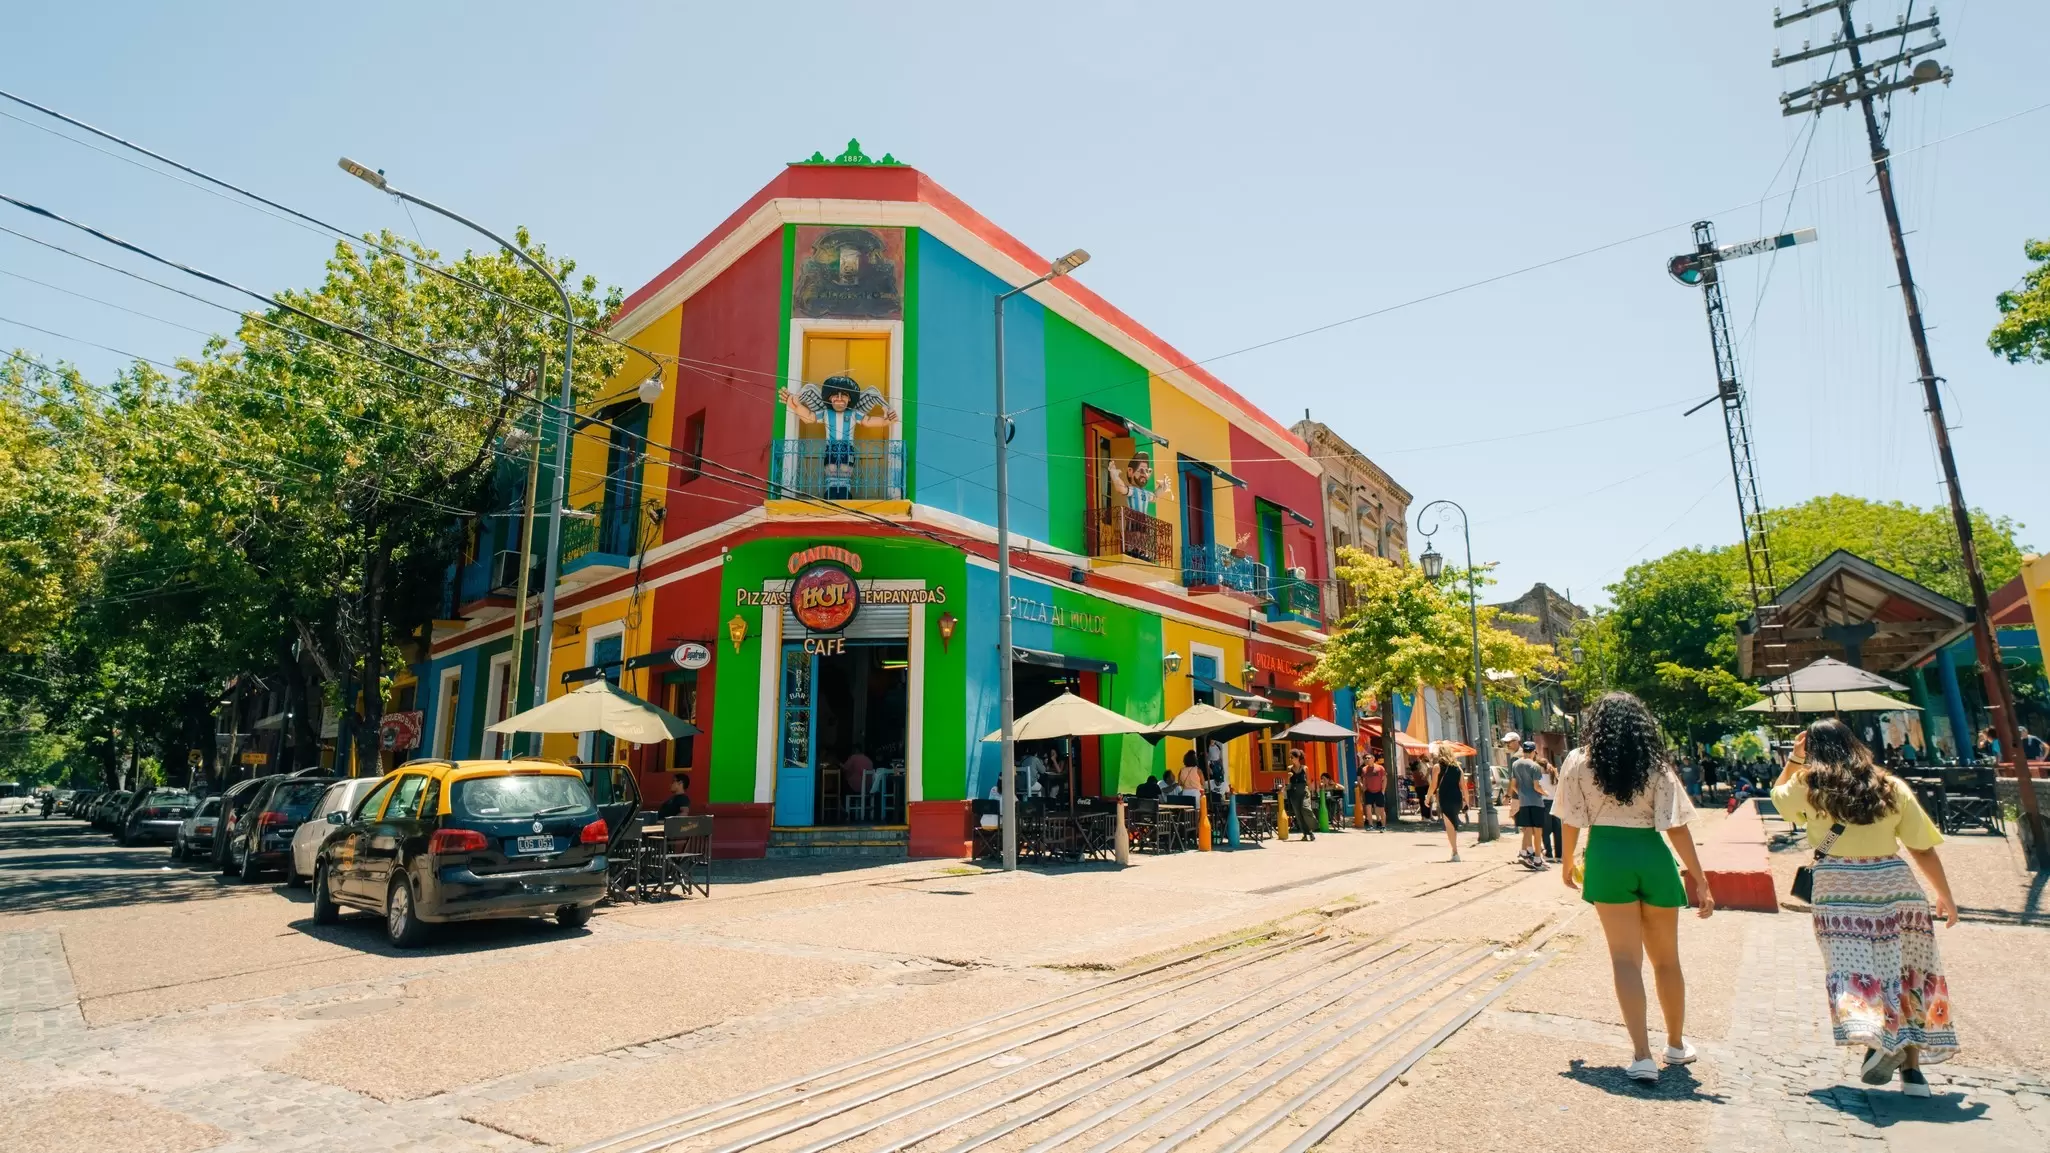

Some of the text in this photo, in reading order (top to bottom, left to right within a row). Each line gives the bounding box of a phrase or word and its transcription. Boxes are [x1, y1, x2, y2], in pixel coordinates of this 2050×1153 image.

[843, 155, 863, 163] 1887
[787, 545, 862, 574] CAMINITO
[737, 588, 787, 606] PIZZAS
[801, 583, 849, 609] HOT
[865, 586, 946, 604] EMPANADAS
[1009, 595, 1047, 623] PIZZA
[1070, 610, 1106, 635] MOLDE
[804, 637, 847, 656] CAFE
[1256, 652, 1276, 672] PIZZA
[789, 692, 805, 700] BAR
